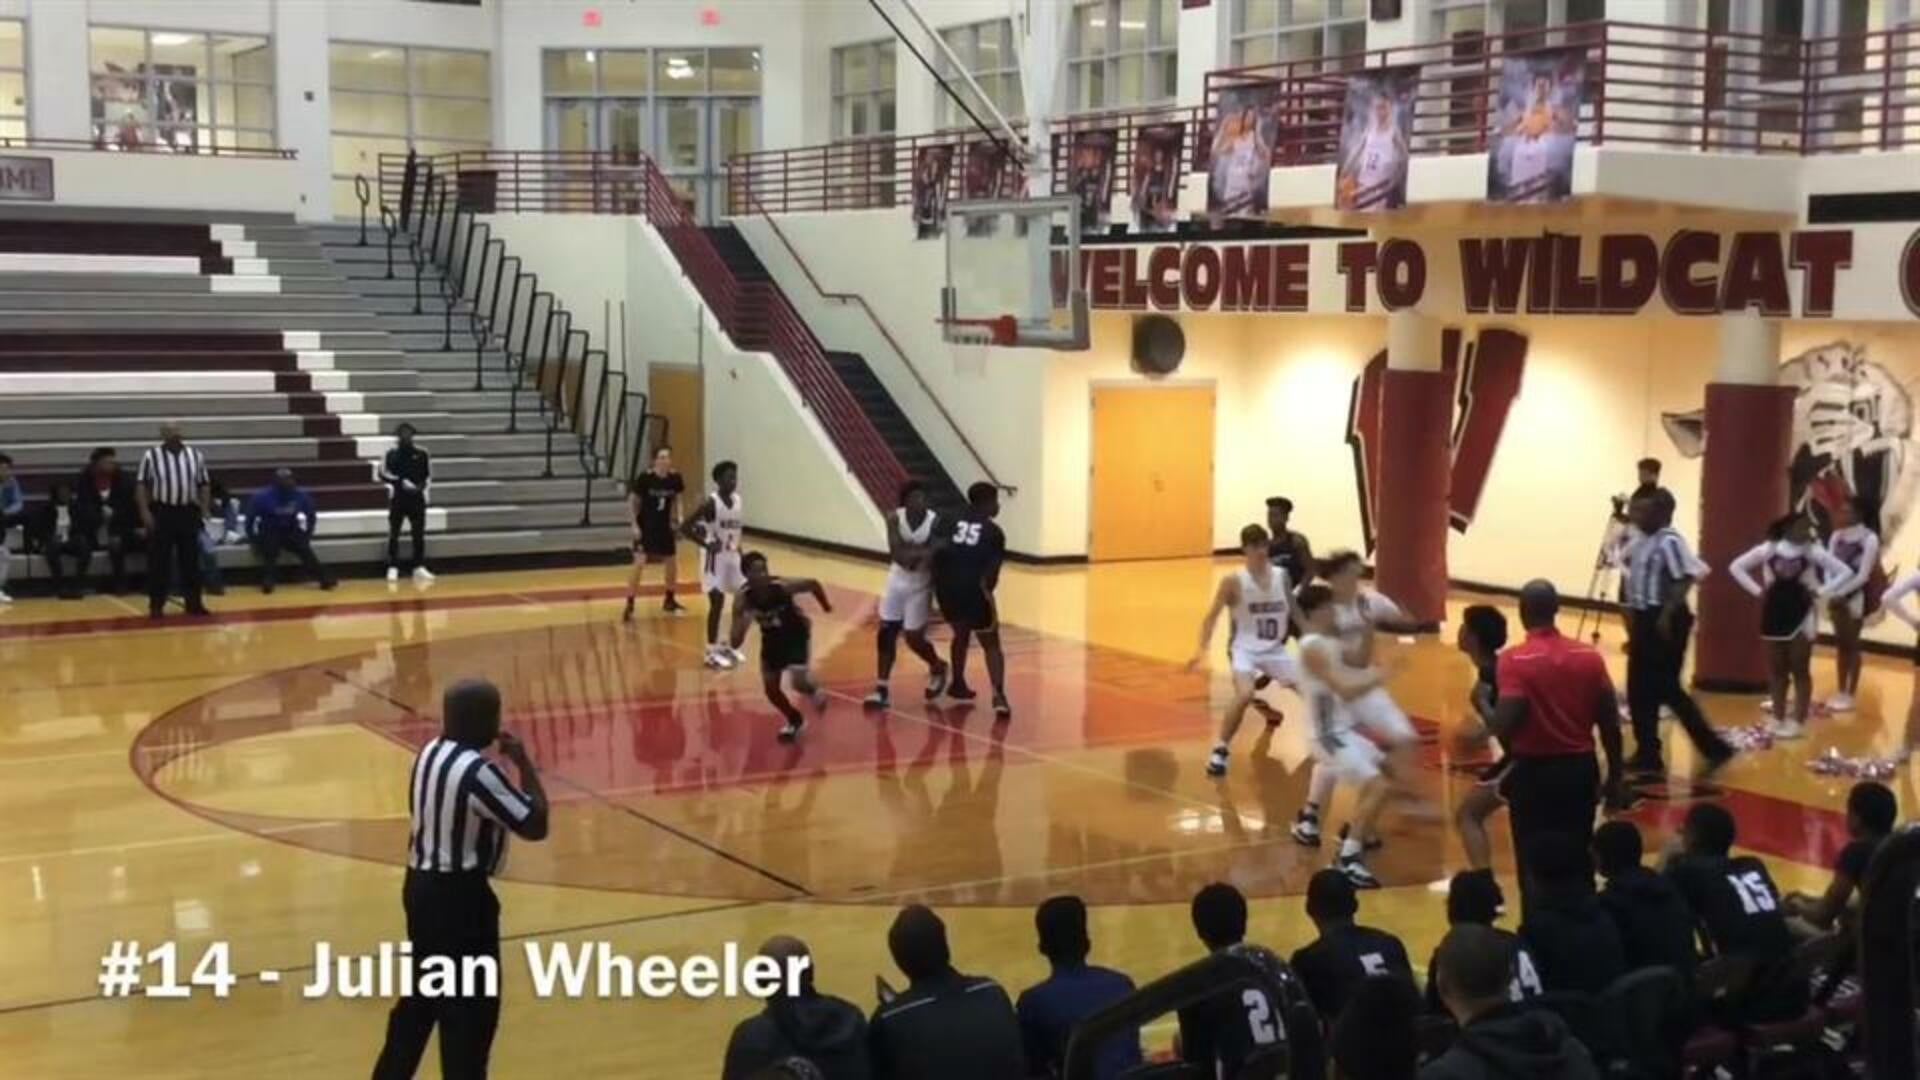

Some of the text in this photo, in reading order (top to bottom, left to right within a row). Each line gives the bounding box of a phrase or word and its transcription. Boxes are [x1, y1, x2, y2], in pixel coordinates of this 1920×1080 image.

[1338, 237, 1427, 312] TO
[1459, 229, 1854, 317] WILDCAT
[952, 520, 982, 546] 35
[1256, 618, 1279, 641] 10
[1727, 871, 1776, 914] 15
